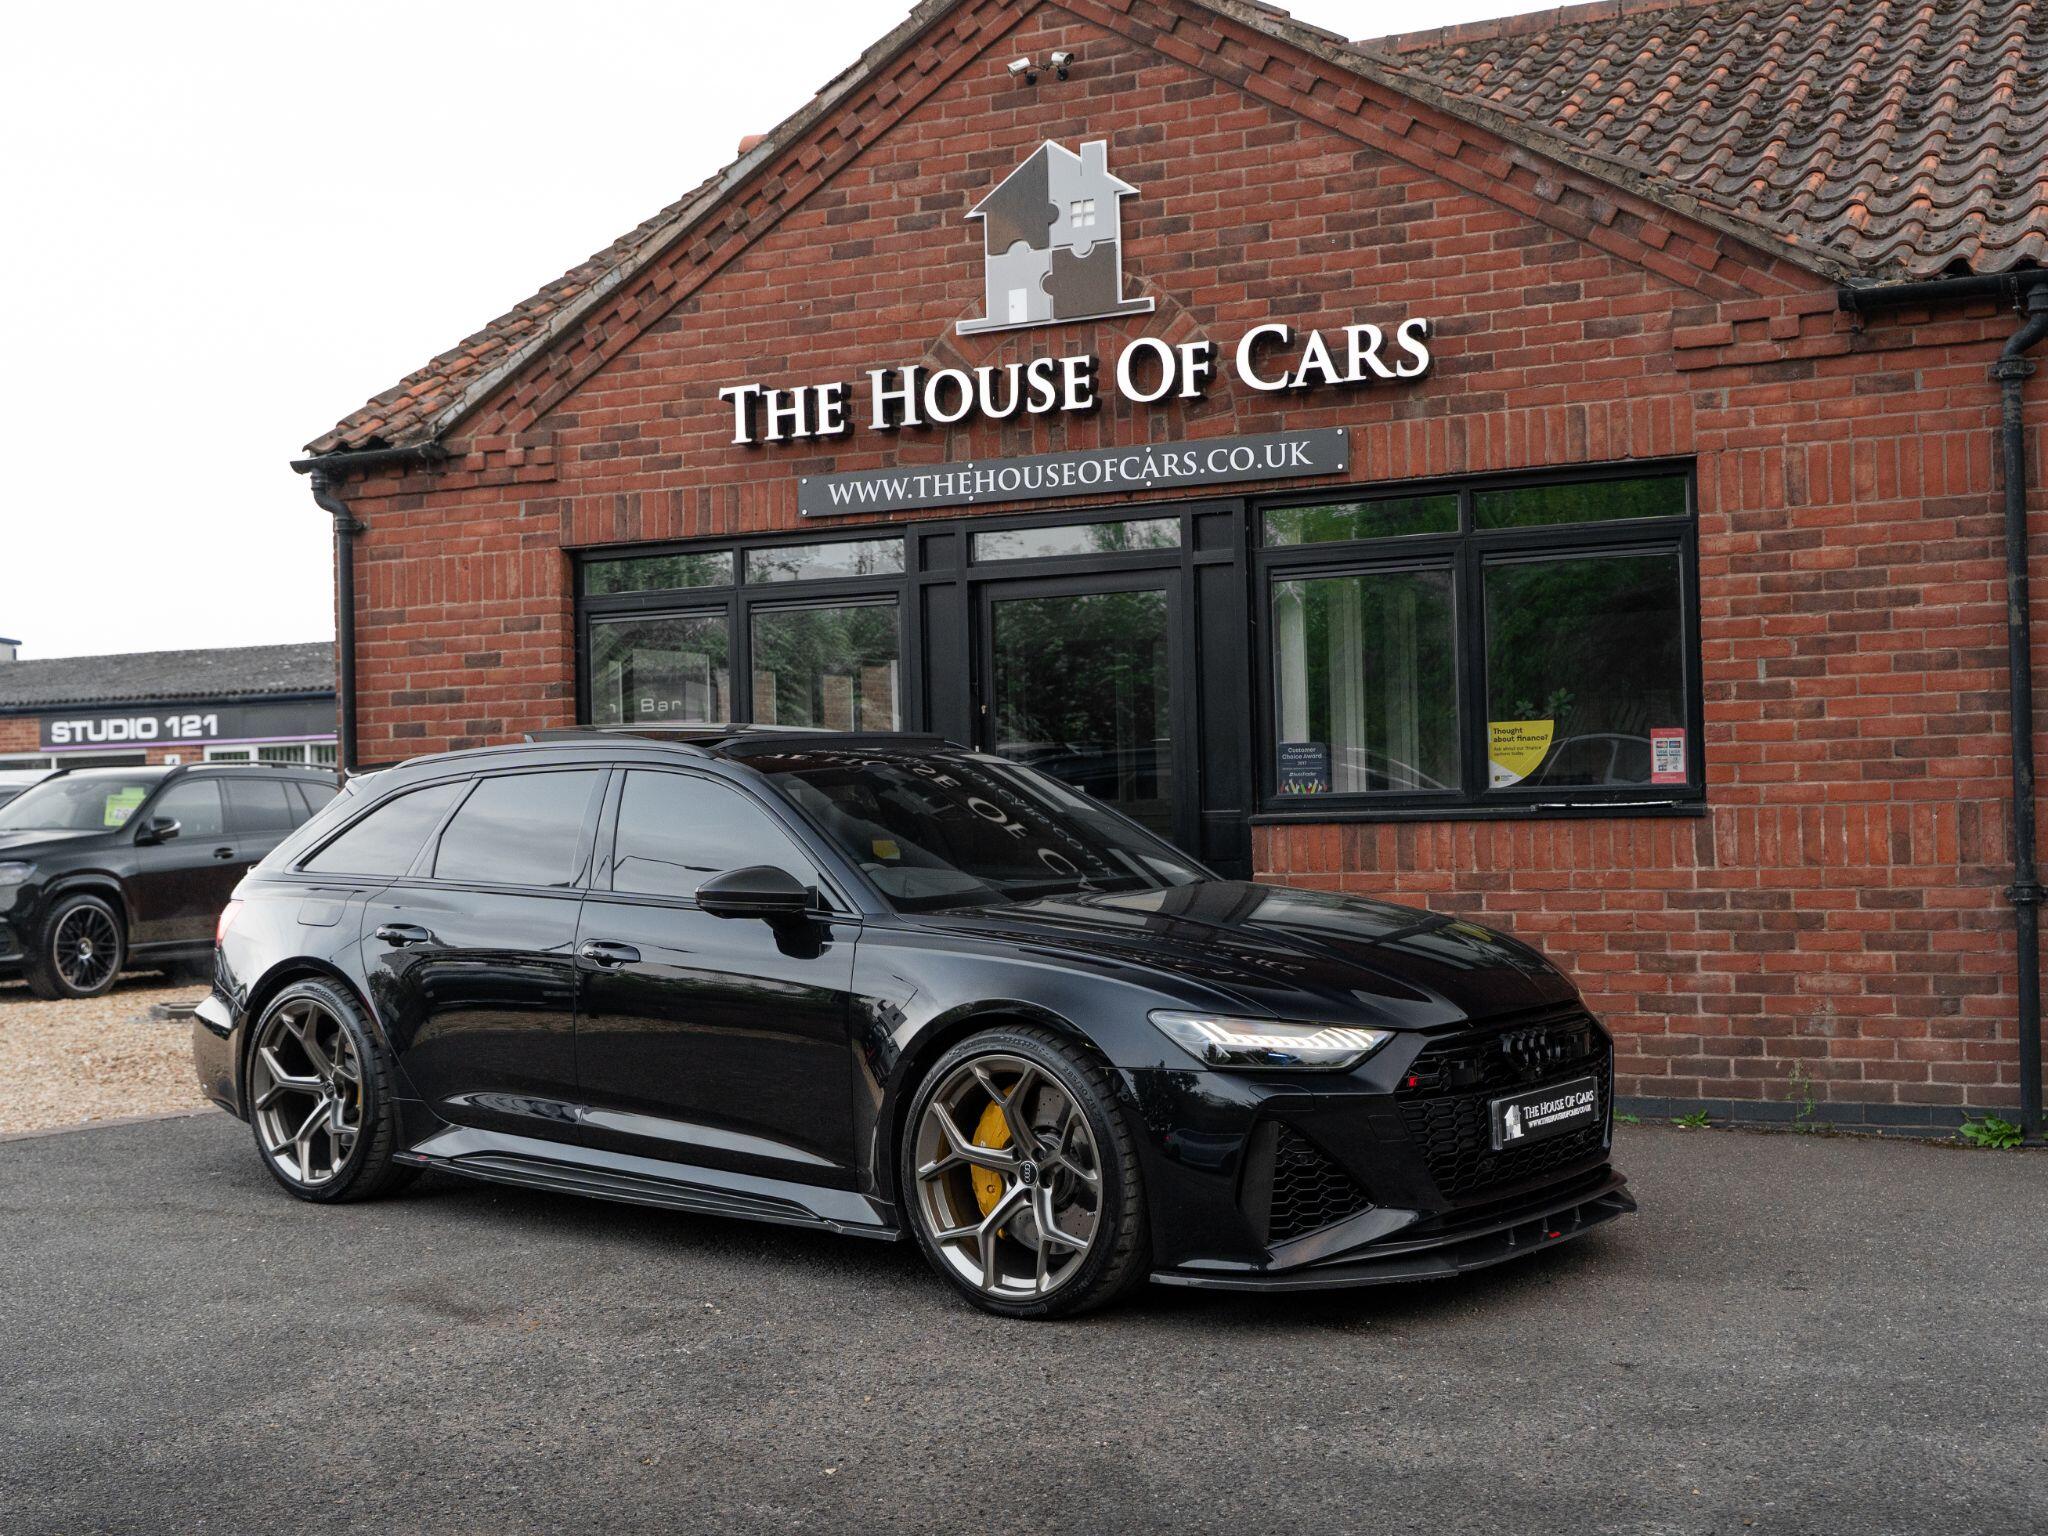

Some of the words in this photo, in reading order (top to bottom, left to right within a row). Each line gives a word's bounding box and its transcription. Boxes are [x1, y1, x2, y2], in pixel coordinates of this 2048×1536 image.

[719, 382, 846, 445] THE
[866, 354, 1095, 430] HOUSE
[1116, 337, 1211, 403] OF
[1235, 317, 1431, 391] CARS
[827, 440, 1314, 506] WWW.THEHOUSEOFCARS.CO.UK
[50, 716, 159, 744] STUDIO
[164, 713, 219, 738] 121
[1523, 1106, 1540, 1119] THE
[1540, 1098, 1565, 1115] HOUSE
[1565, 1095, 1576, 1108] OF
[1575, 1090, 1594, 1105] CARS
